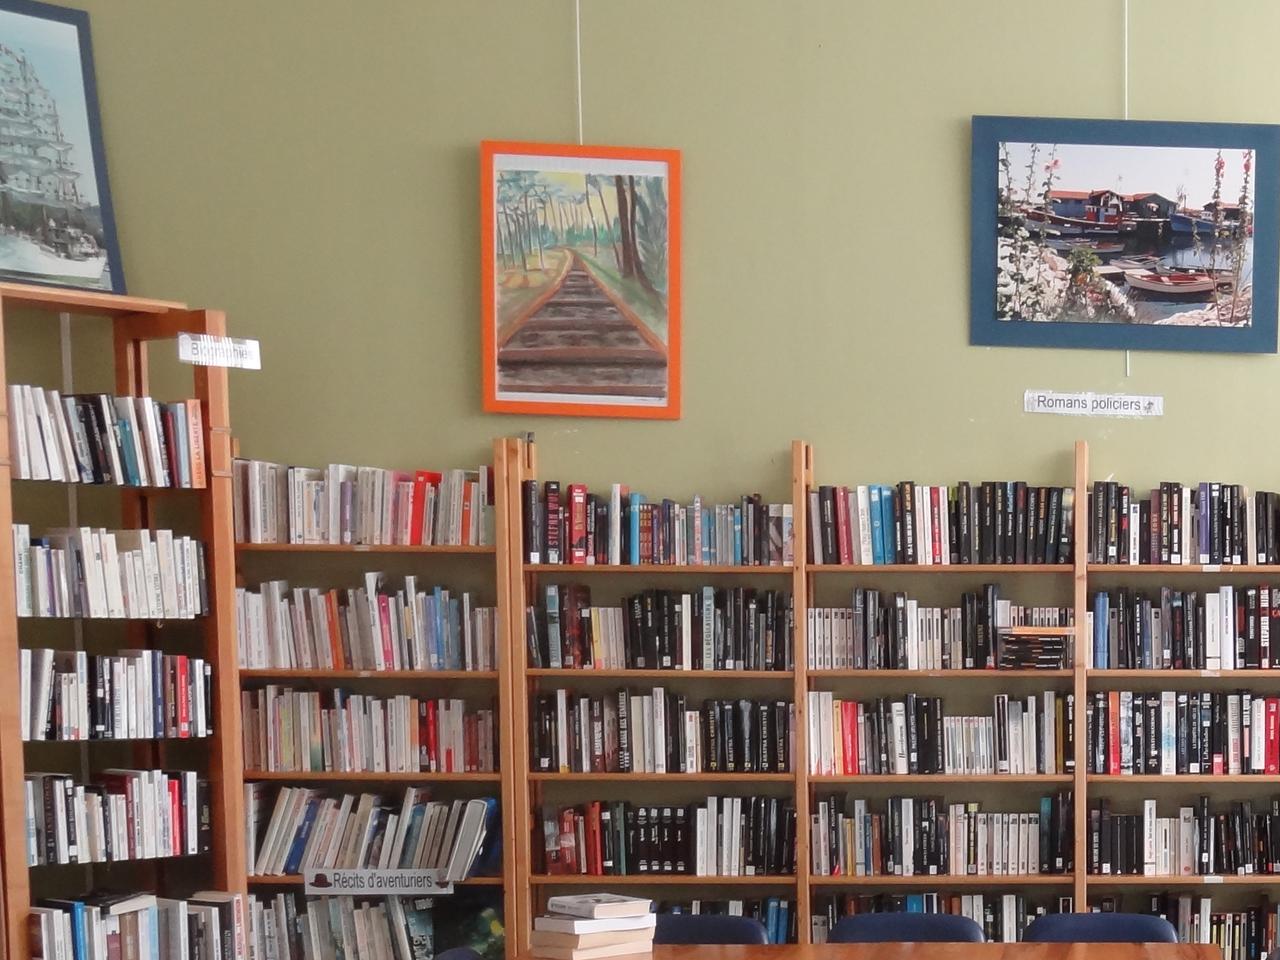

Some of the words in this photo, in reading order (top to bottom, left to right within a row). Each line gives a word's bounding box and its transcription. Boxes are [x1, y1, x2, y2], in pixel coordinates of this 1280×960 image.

[1037, 395, 1087, 409] Romans
[1091, 397, 1141, 412] policiers
[548, 493, 559, 510] WUL
[547, 513, 560, 546] STEFAN
[1261, 589, 1269, 608] KING
[1261, 616, 1269, 647] STEPHEN
[333, 872, 365, 888] Récits
[368, 872, 432, 889] d'aventuriers
